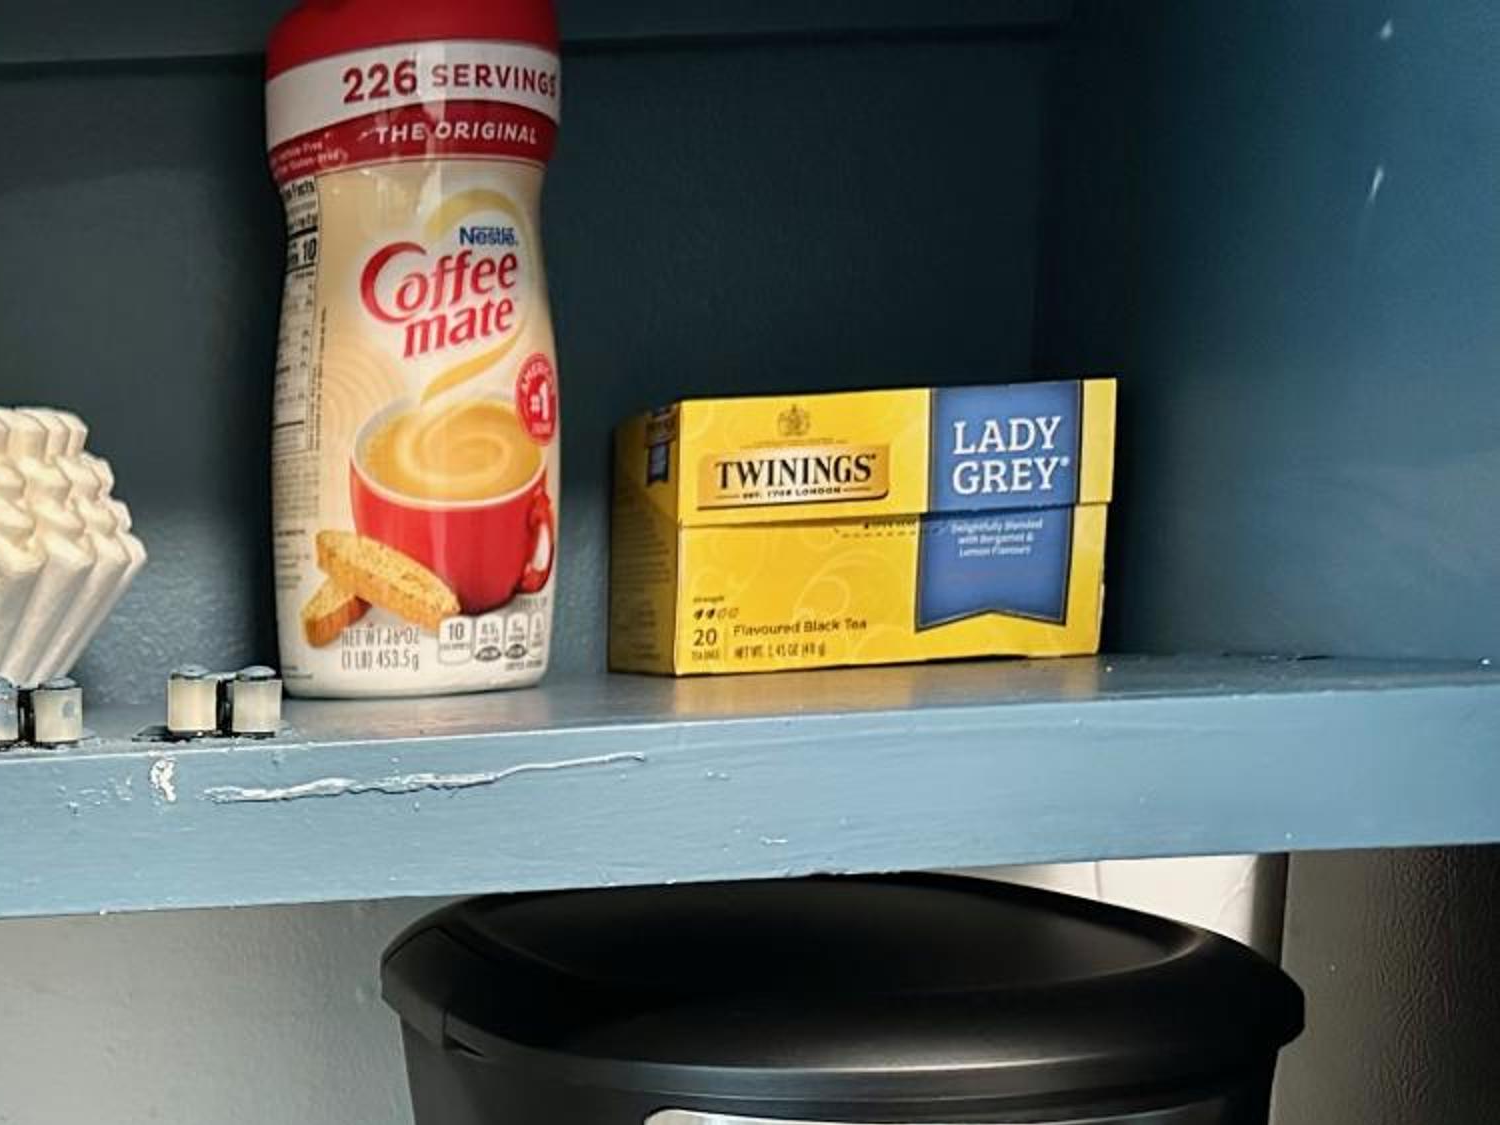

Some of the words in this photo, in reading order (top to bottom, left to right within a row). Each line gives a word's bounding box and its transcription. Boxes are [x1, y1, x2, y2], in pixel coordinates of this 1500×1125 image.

[342, 59, 418, 103] 226
[432, 63, 557, 98] SERVINGS
[375, 121, 424, 145] THE
[434, 120, 537, 144] ORIGINAL
[360, 241, 519, 324] Coffee
[403, 298, 514, 359] mate
[953, 416, 1061, 454] LADY
[715, 453, 872, 489] TWININGS
[952, 457, 1060, 495] GREY
[449, 622, 465, 641] 10
[693, 628, 718, 647] 20
[733, 622, 801, 637] Flavoured
[803, 619, 840, 633] Black
[844, 618, 867, 630] Tea
